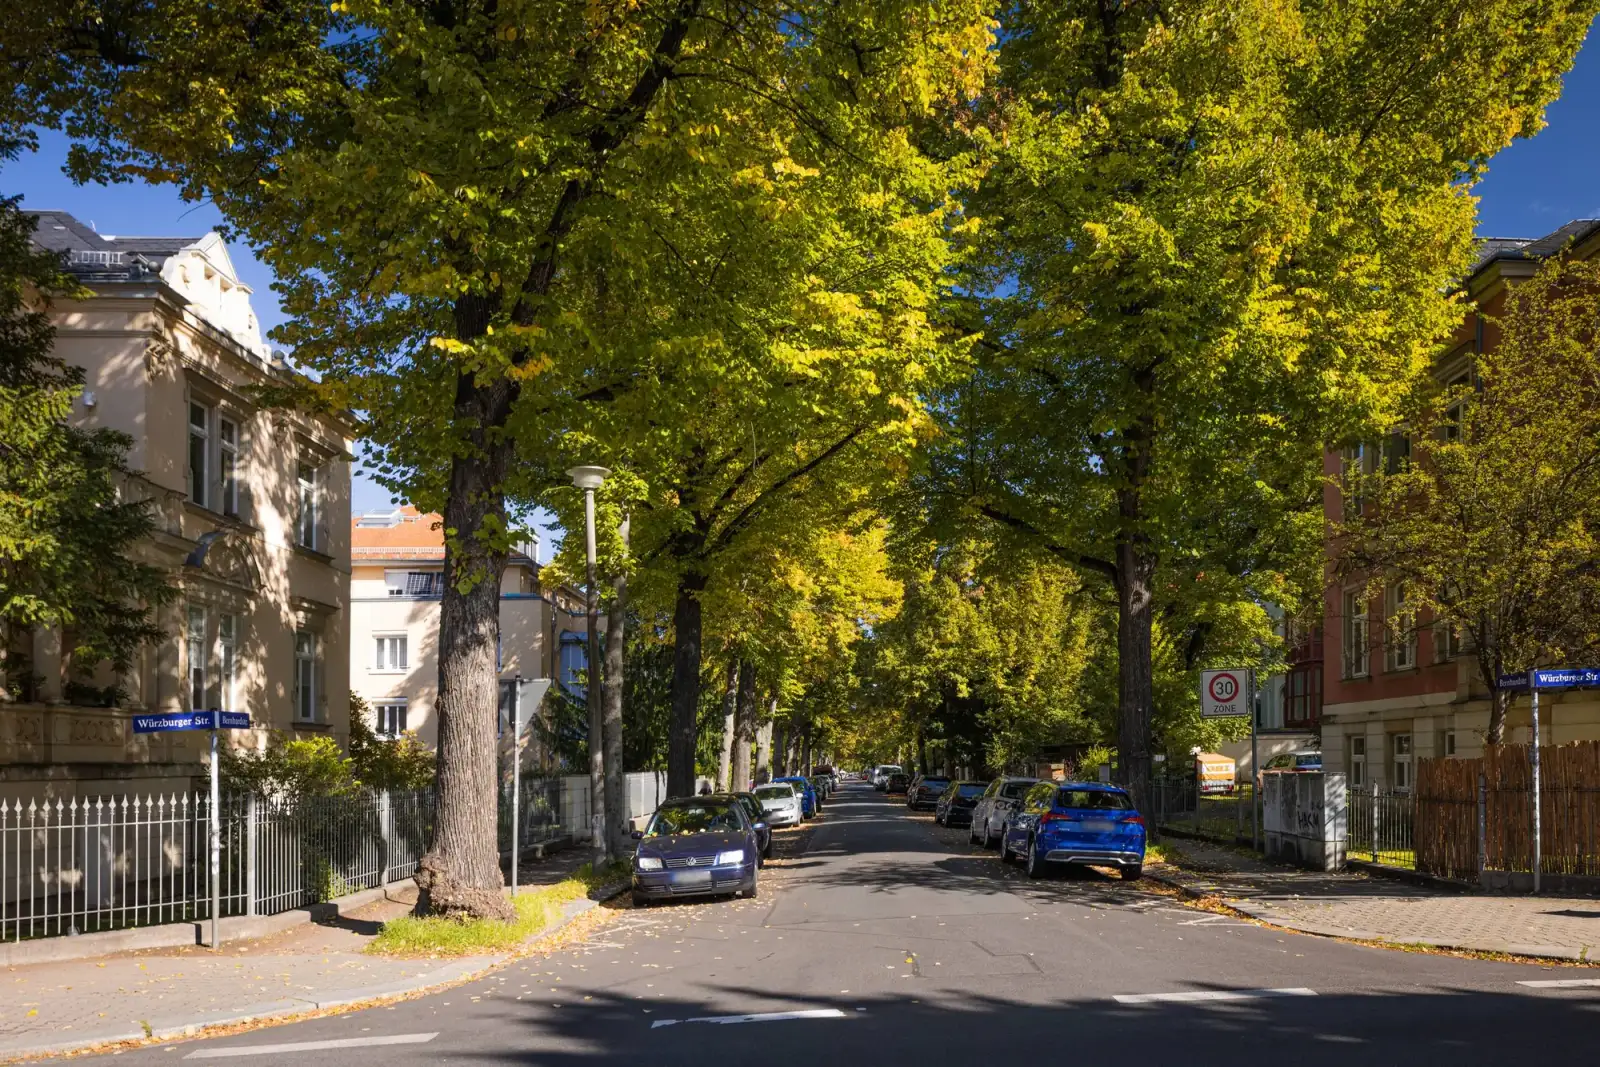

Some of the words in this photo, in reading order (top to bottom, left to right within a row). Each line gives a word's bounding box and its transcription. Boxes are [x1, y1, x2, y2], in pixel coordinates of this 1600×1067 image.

[1539, 673, 1584, 683] Würzburger
[1215, 681, 1233, 695] 30
[1213, 704, 1237, 713] ZONE
[137, 718, 193, 728] Würzburger
[194, 716, 210, 726] Str.
